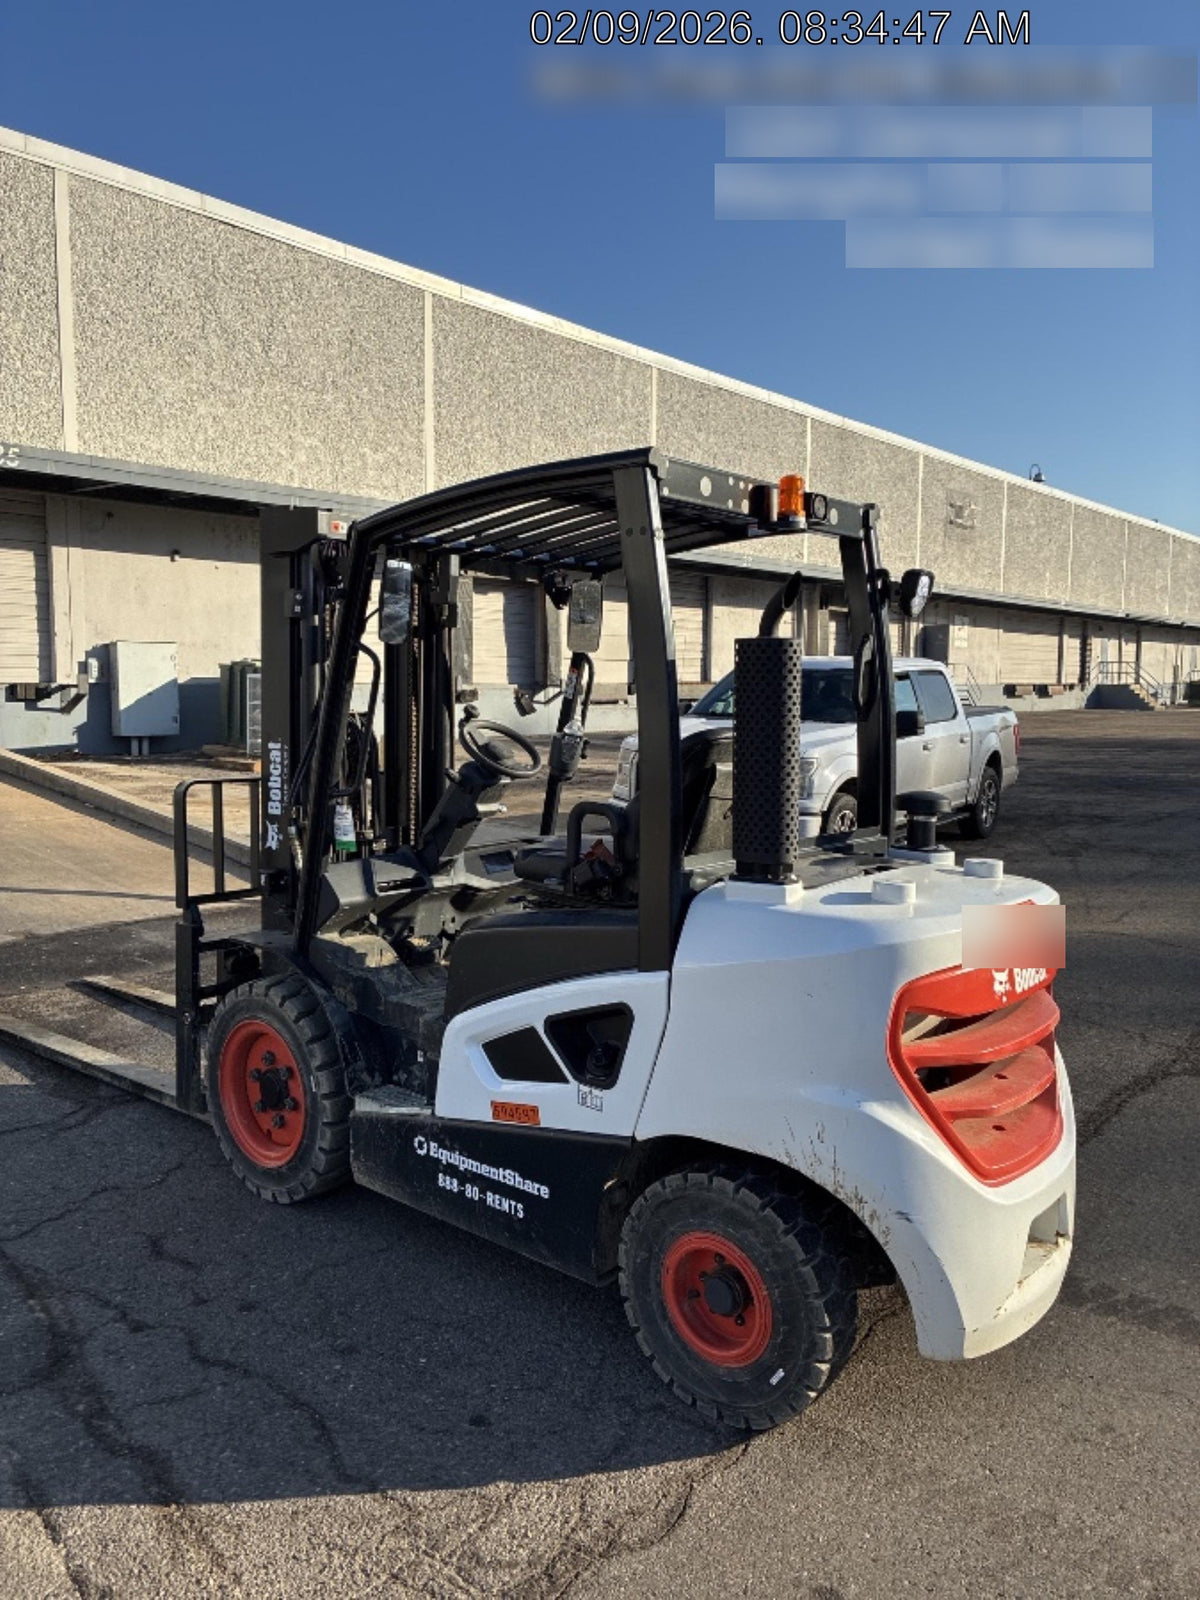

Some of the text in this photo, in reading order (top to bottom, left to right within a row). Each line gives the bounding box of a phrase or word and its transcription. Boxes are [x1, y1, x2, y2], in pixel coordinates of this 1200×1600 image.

[267, 742, 281, 815] Bobcat
[429, 1140, 550, 1199] EquipmentShare
[438, 1172, 525, 1219] 888-80-RENTS
